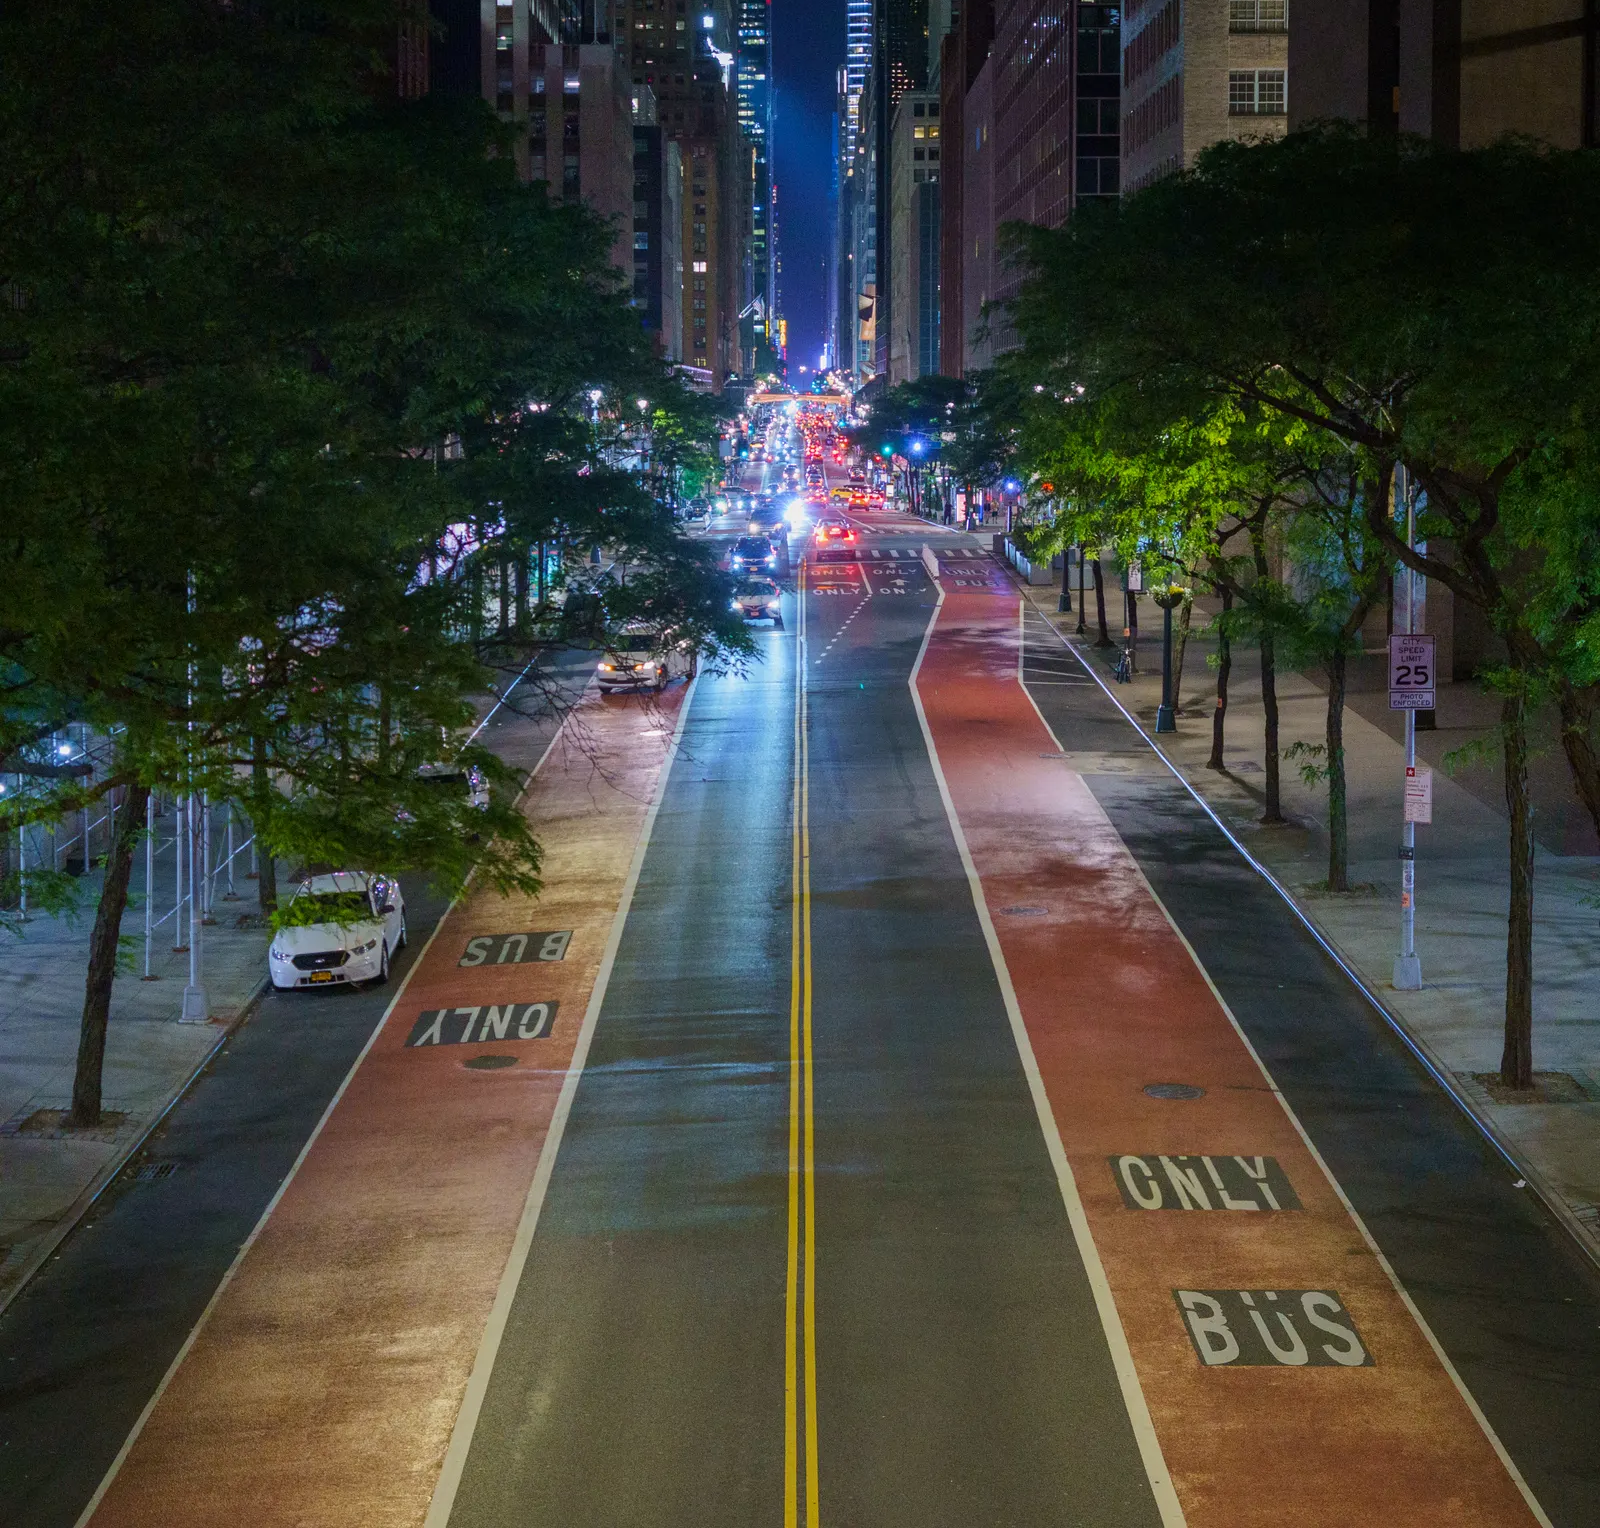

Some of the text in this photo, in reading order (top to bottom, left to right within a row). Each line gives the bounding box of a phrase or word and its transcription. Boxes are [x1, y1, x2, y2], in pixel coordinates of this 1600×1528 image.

[810, 568, 856, 576] ONLY
[872, 568, 917, 576] ONLY
[945, 568, 991, 576] ONLY
[954, 579, 1000, 587] BUS
[812, 588, 861, 596] ONLY
[879, 587, 927, 595] ONY
[1398, 646, 1425, 654] SPEED
[1401, 655, 1423, 663] LIMIT
[1395, 665, 1429, 685] 25
[1392, 699, 1431, 707] ENFORCED
[459, 930, 573, 967] BUS
[413, 1003, 549, 1047] ONLY
[1118, 1155, 1281, 1211] ONLY
[1177, 1290, 1366, 1366] BUS
